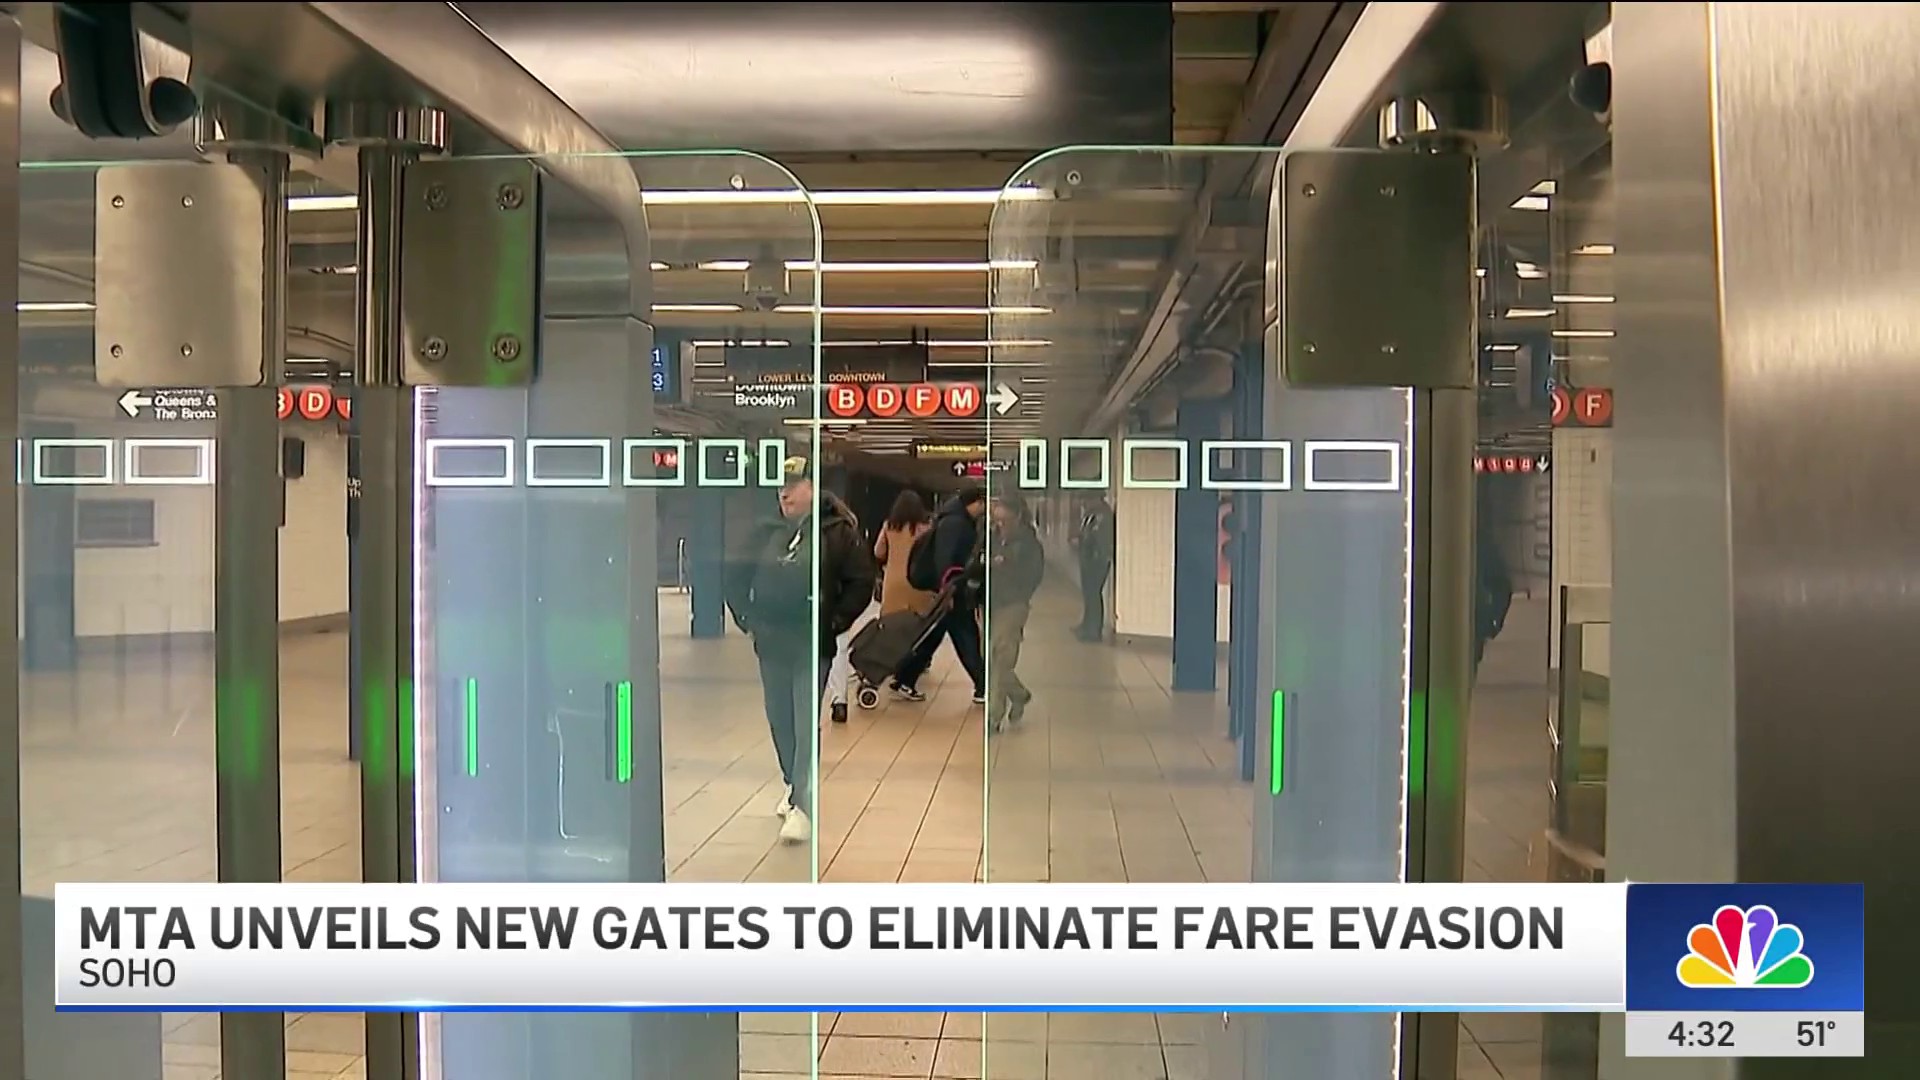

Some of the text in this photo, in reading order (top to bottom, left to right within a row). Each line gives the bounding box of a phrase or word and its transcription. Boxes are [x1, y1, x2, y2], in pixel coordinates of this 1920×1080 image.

[829, 373, 886, 382] DOWNTOWN
[154, 394, 217, 407] Queens &
[307, 393, 324, 412] D
[735, 388, 973, 409] Brooklyn B D F M
[1586, 394, 1602, 417] F
[154, 407, 177, 419] The
